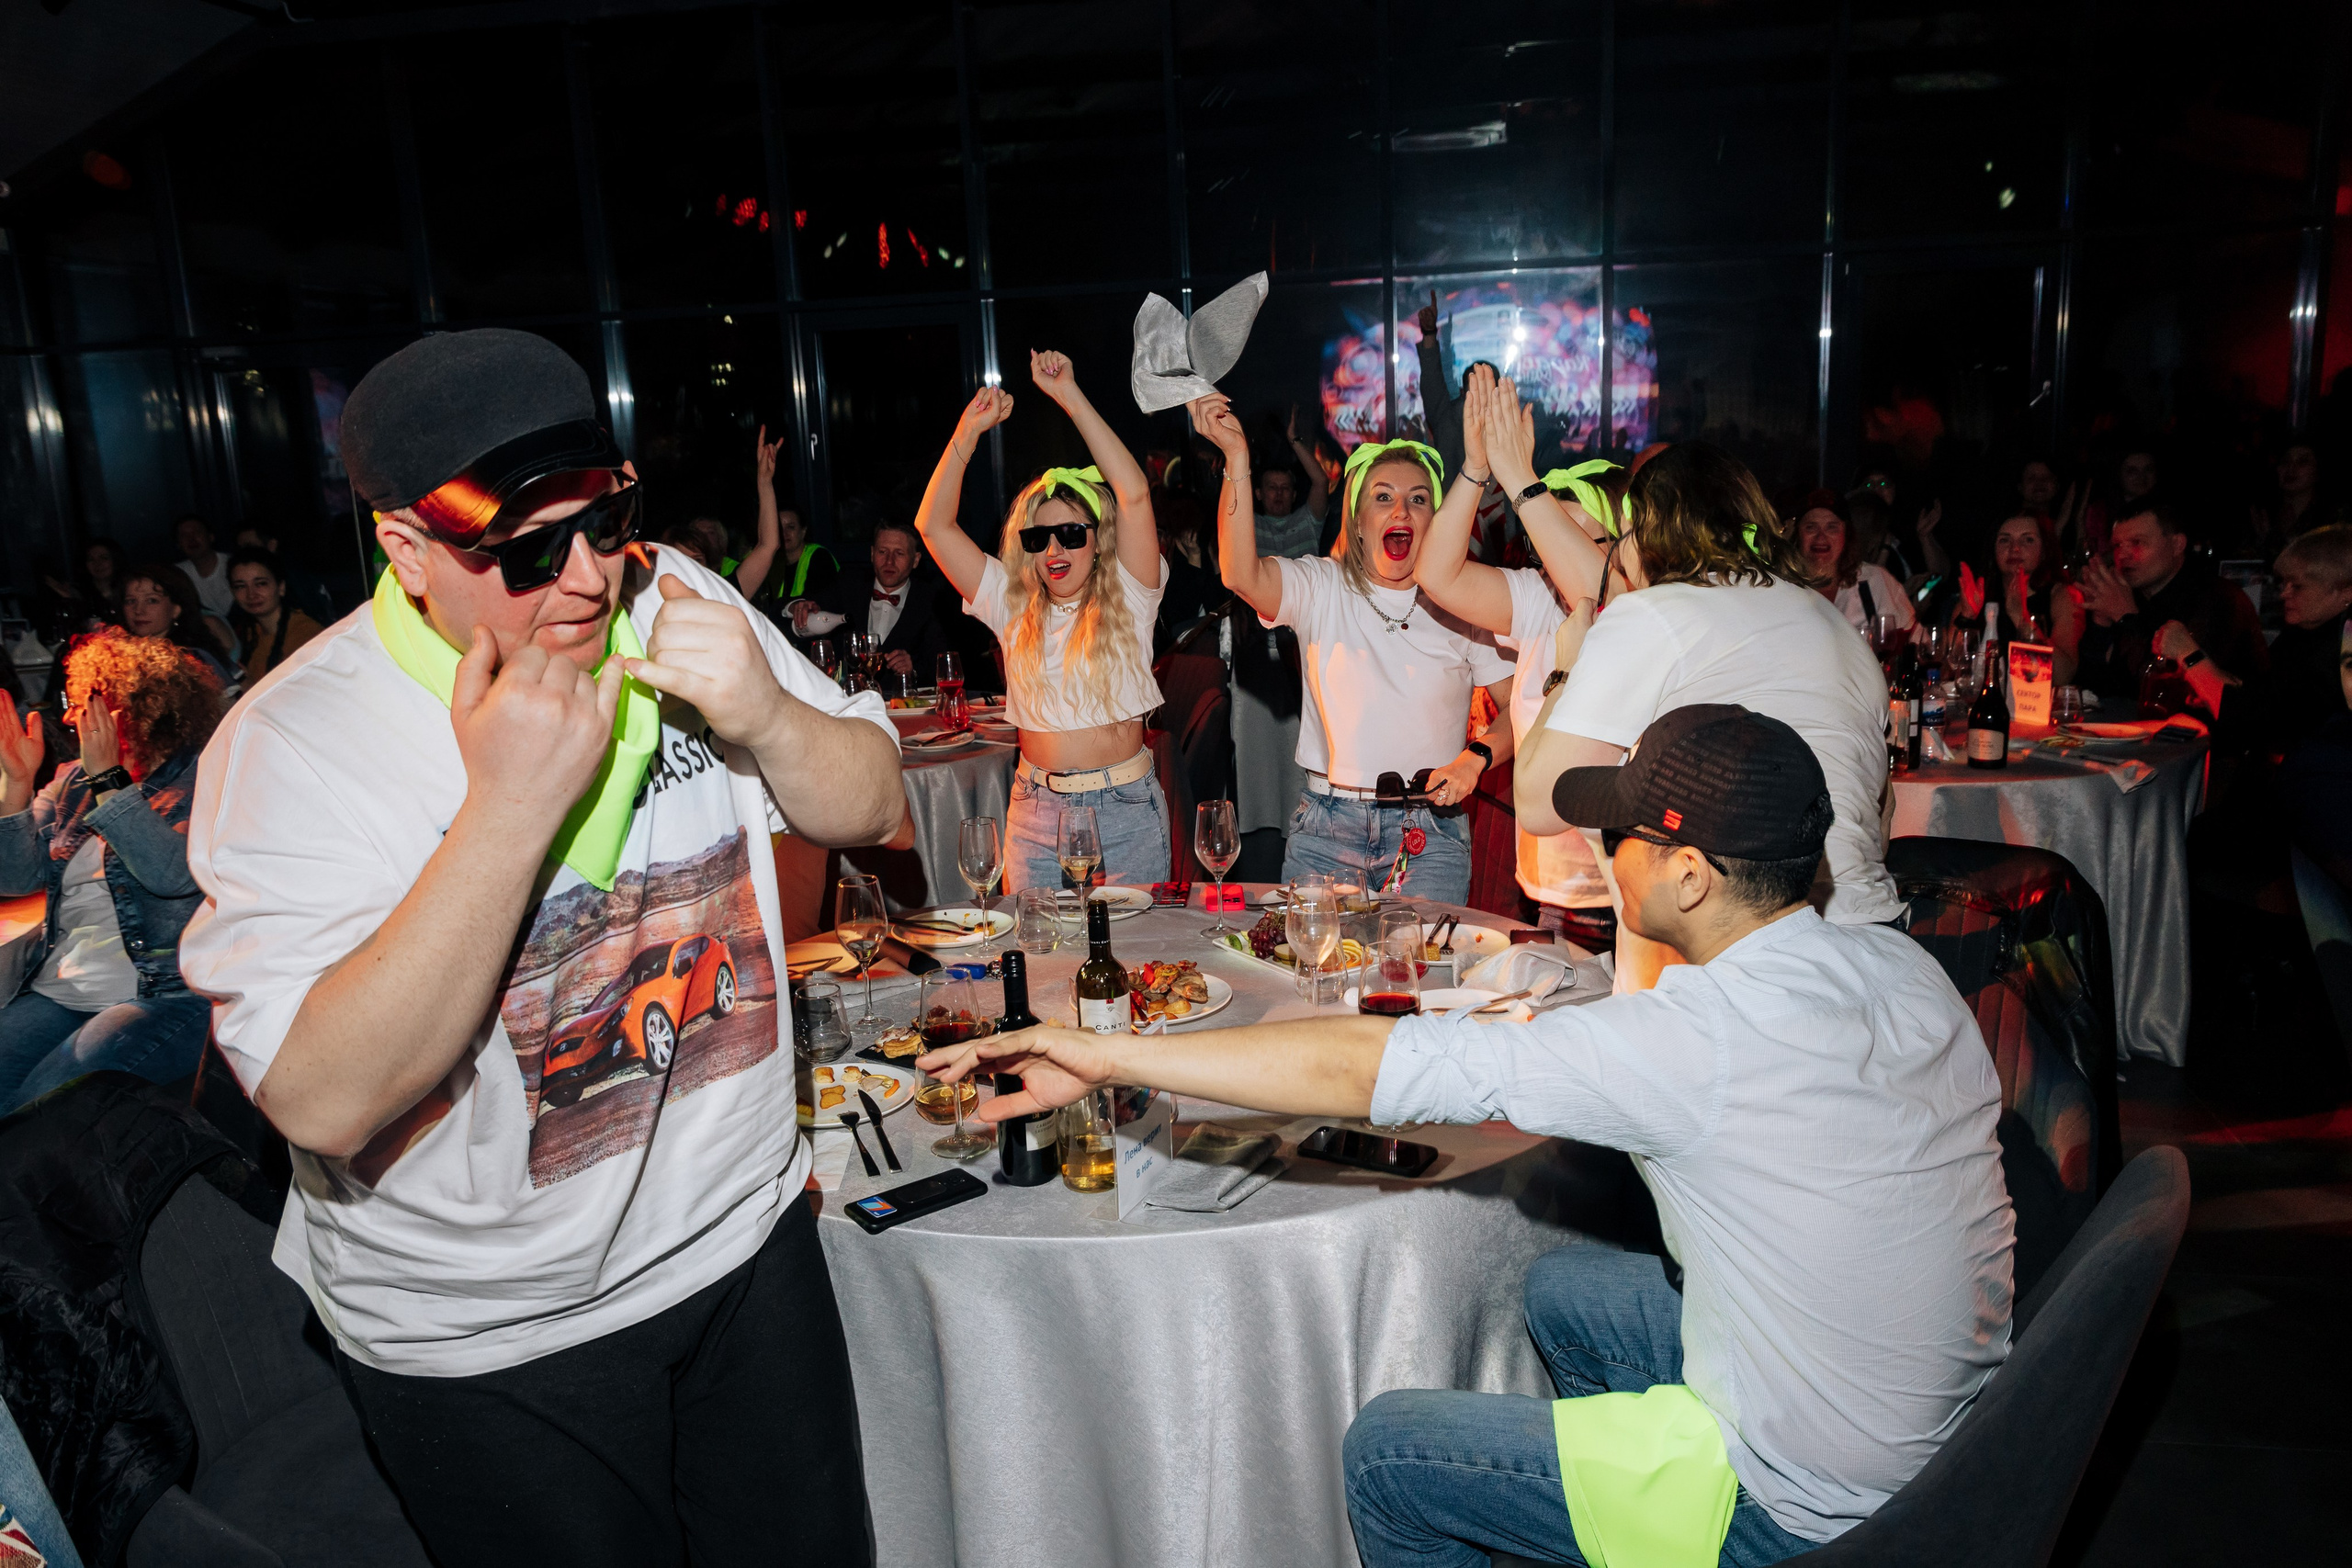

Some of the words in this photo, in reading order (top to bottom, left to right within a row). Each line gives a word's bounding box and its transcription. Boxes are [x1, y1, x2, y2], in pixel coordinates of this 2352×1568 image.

[1095, 1021, 1125, 1031] CANTI
[1124, 1142, 1142, 1165] Лена
[1143, 1123, 1162, 1147] верит
[1136, 1168, 1141, 1179] в
[1141, 1156, 1153, 1173] нас
